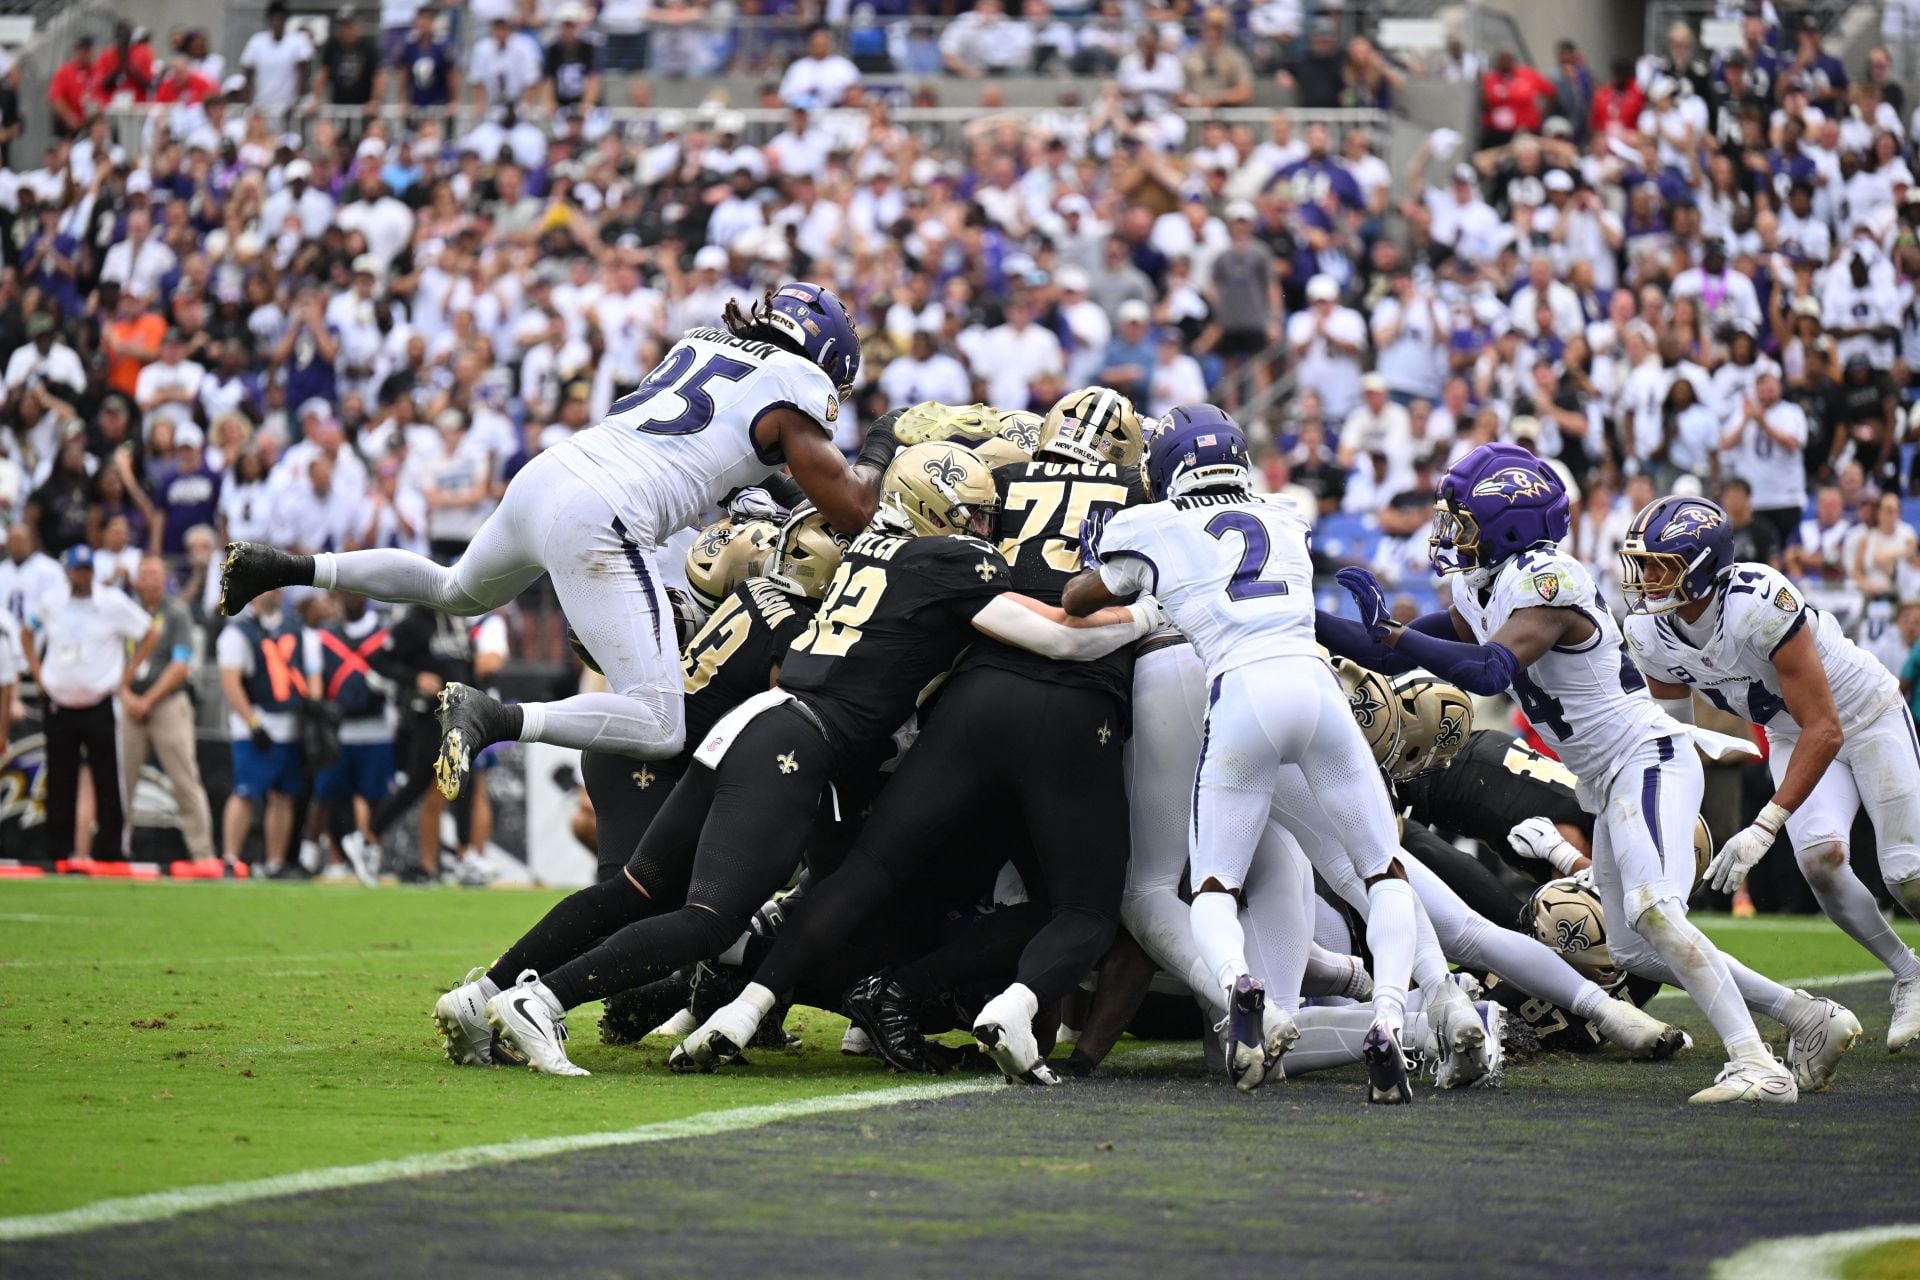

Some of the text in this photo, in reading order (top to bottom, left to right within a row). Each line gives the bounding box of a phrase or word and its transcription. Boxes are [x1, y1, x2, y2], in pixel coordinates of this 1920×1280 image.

[1025, 462, 1117, 478] FUAGA
[1000, 481, 1128, 573] 75
[1204, 511, 1288, 602] 2
[1519, 997, 1568, 1039] 87
